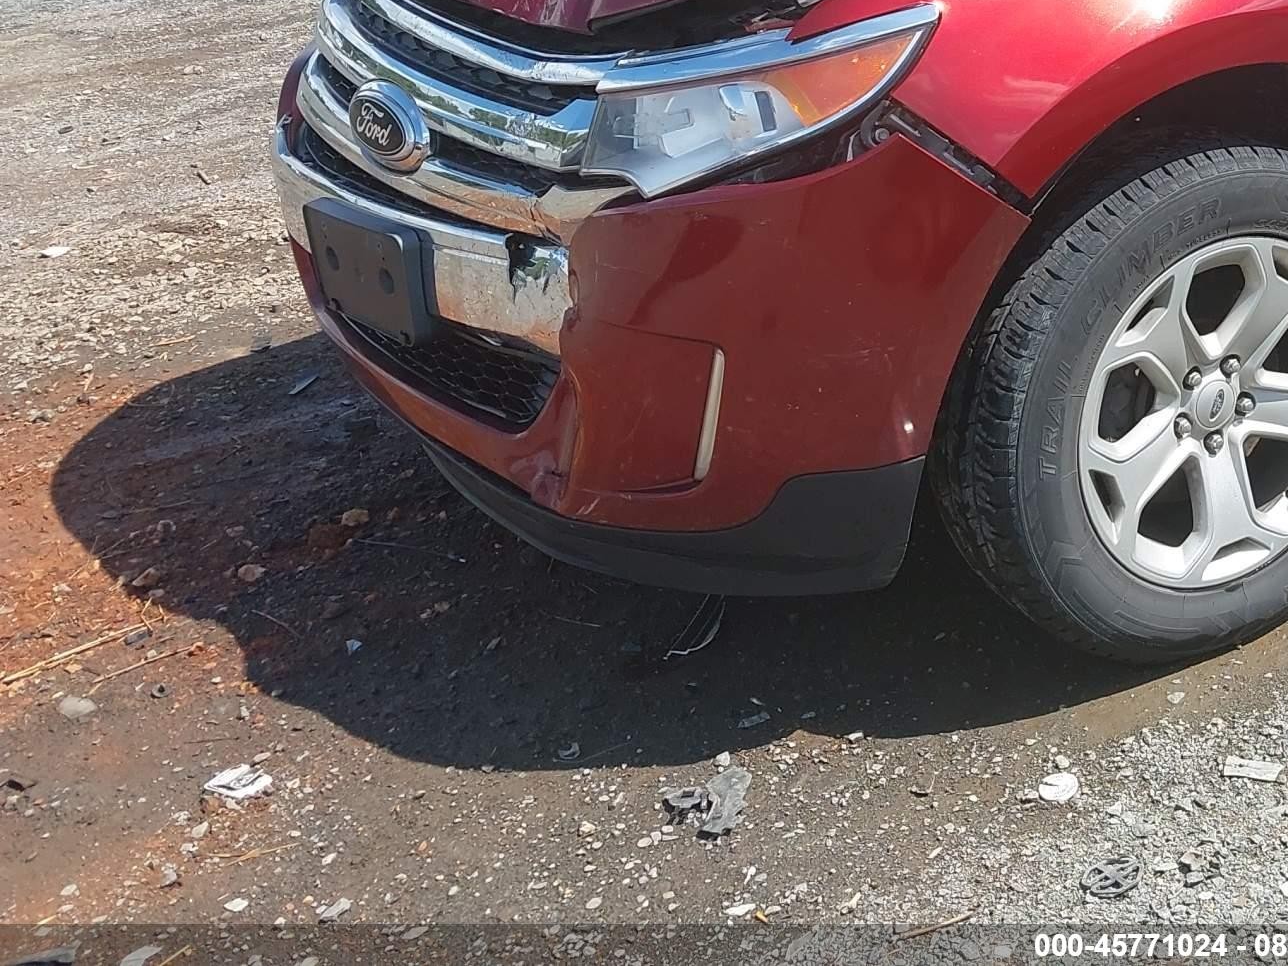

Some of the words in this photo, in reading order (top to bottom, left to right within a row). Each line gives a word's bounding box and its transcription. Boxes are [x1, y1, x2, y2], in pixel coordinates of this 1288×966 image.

[356, 102, 393, 146] Ford
[1038, 360, 1073, 481] TRAIL
[1081, 196, 1222, 336] CLIMBER
